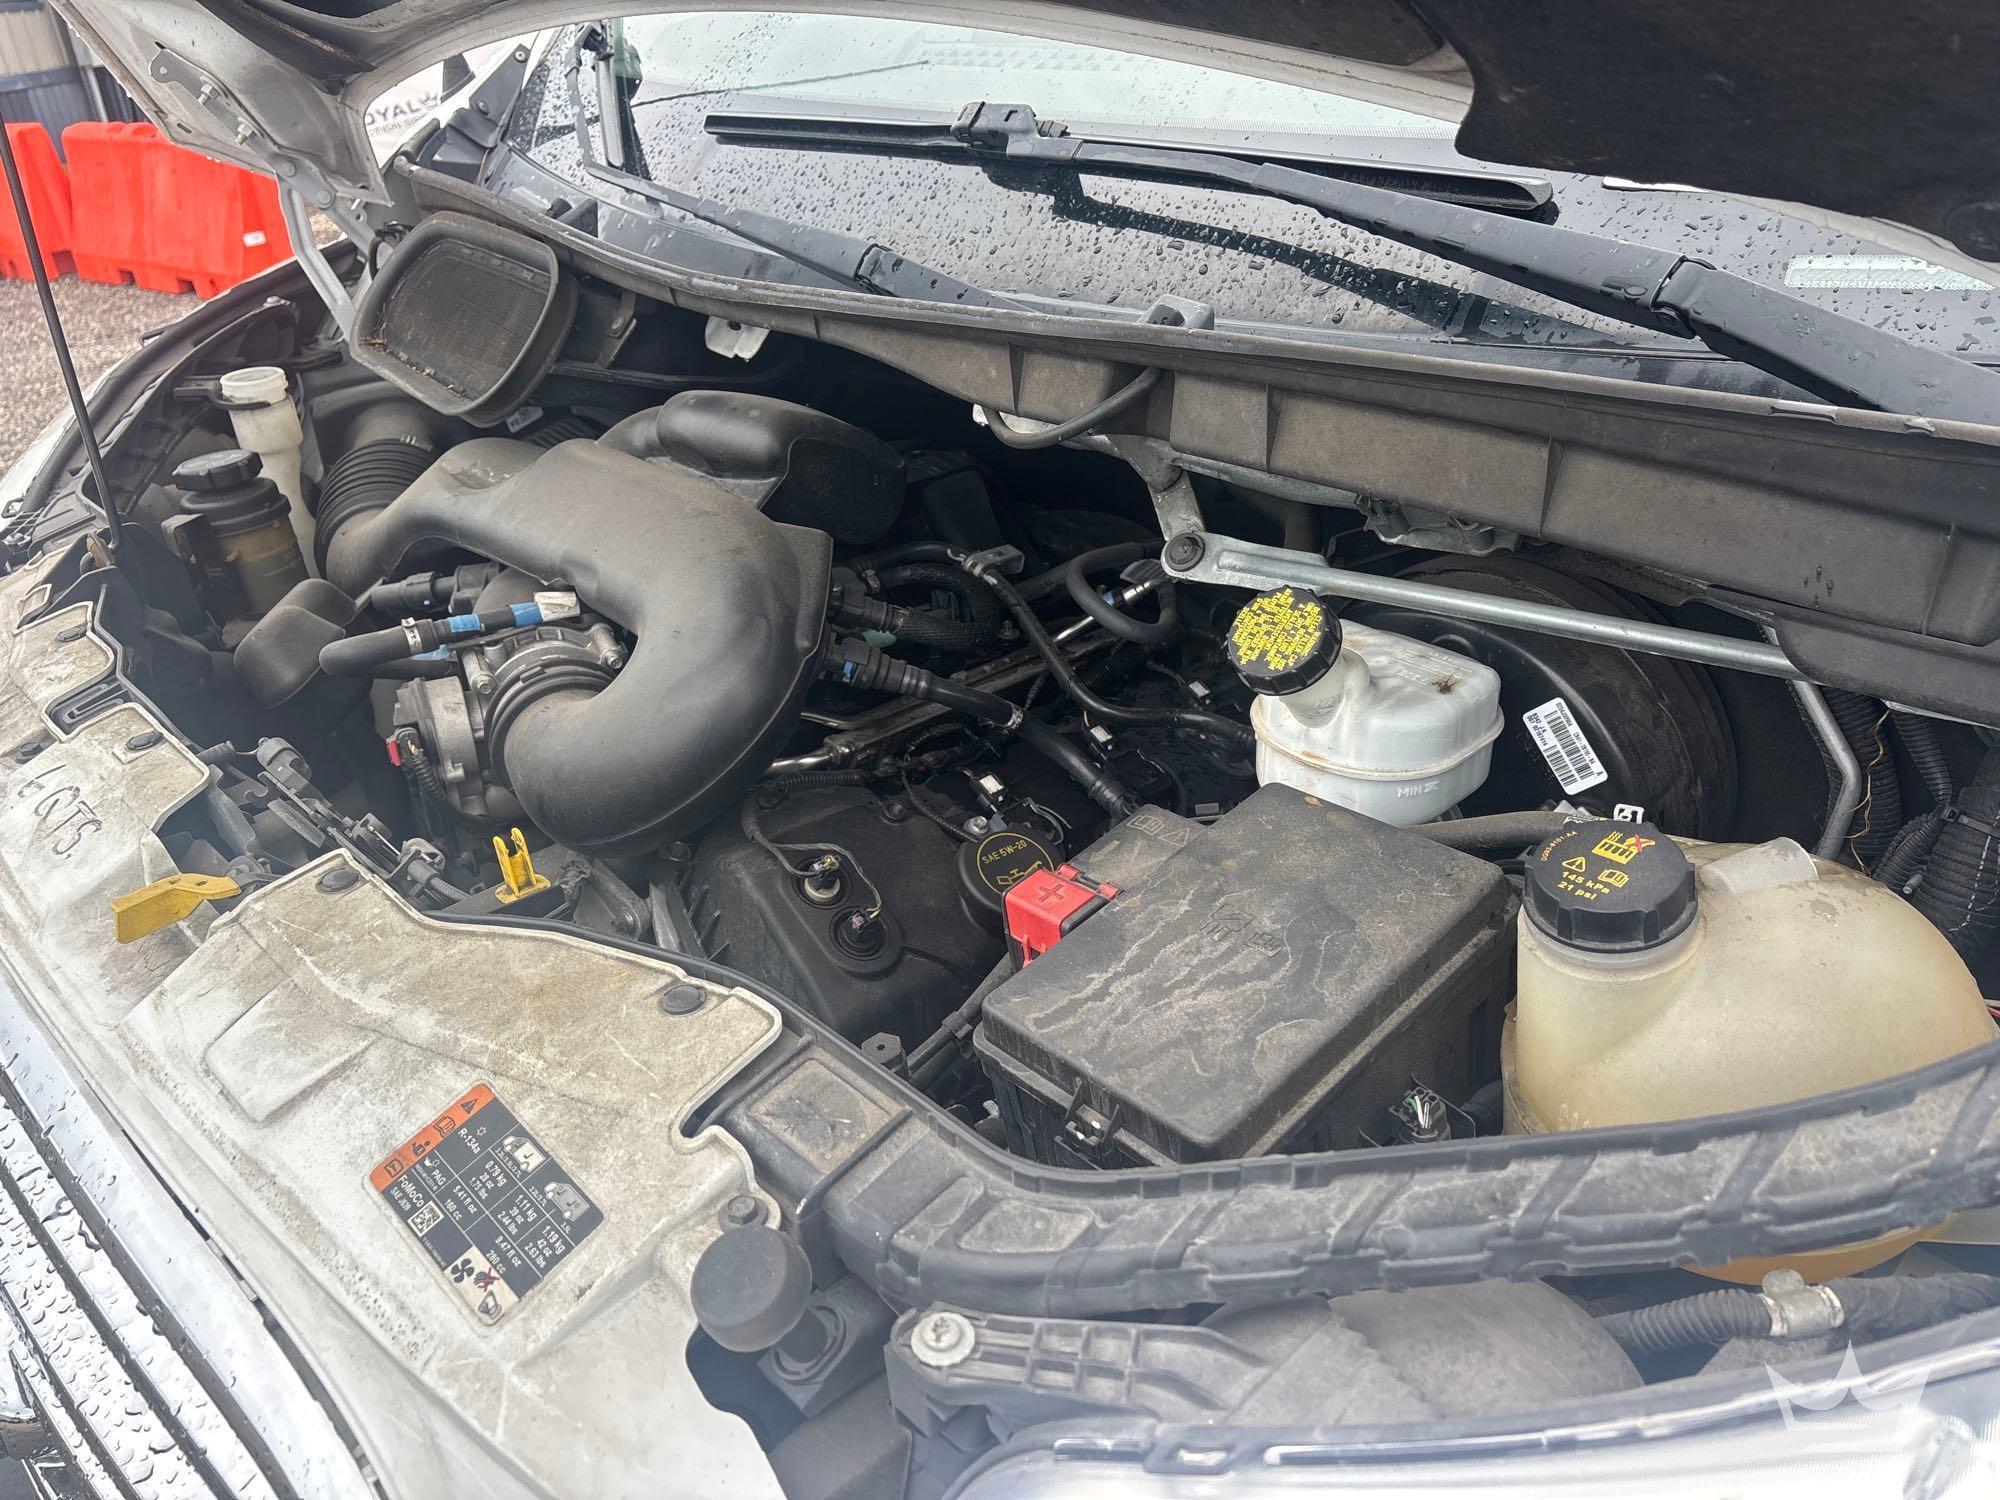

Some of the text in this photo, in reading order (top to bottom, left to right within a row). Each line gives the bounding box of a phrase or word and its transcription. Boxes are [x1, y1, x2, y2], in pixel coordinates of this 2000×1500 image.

[1397, 785, 1422, 798] MIN
[982, 840, 1027, 864] SAE 5W-20
[1557, 881, 1597, 900] 21 psi
[1562, 871, 1610, 894] 145 kPa
[457, 1127, 482, 1154] R-134a
[430, 1168, 447, 1185] PAG
[478, 1171, 494, 1189] 28 oz
[484, 1159, 509, 1187] 0.79 kg
[388, 1186, 403, 1200] SAE
[396, 1174, 427, 1208] FoMoCo
[468, 1176, 490, 1199] 1.75 lbs
[443, 1198, 462, 1220] 160 cc
[466, 1203, 477, 1214] oz
[508, 1205, 524, 1224] 39 oz
[513, 1193, 539, 1222] 1.11 kg
[496, 1210, 520, 1235] 2.44 lbs
[493, 1235, 511, 1252] 9.47
[510, 1255, 522, 1267] oz
[535, 1237, 553, 1257] 42 oz
[540, 1224, 568, 1255] 1.19 kg
[485, 1249, 507, 1274] 280 cc
[523, 1241, 548, 1268] 2.63 lbs
